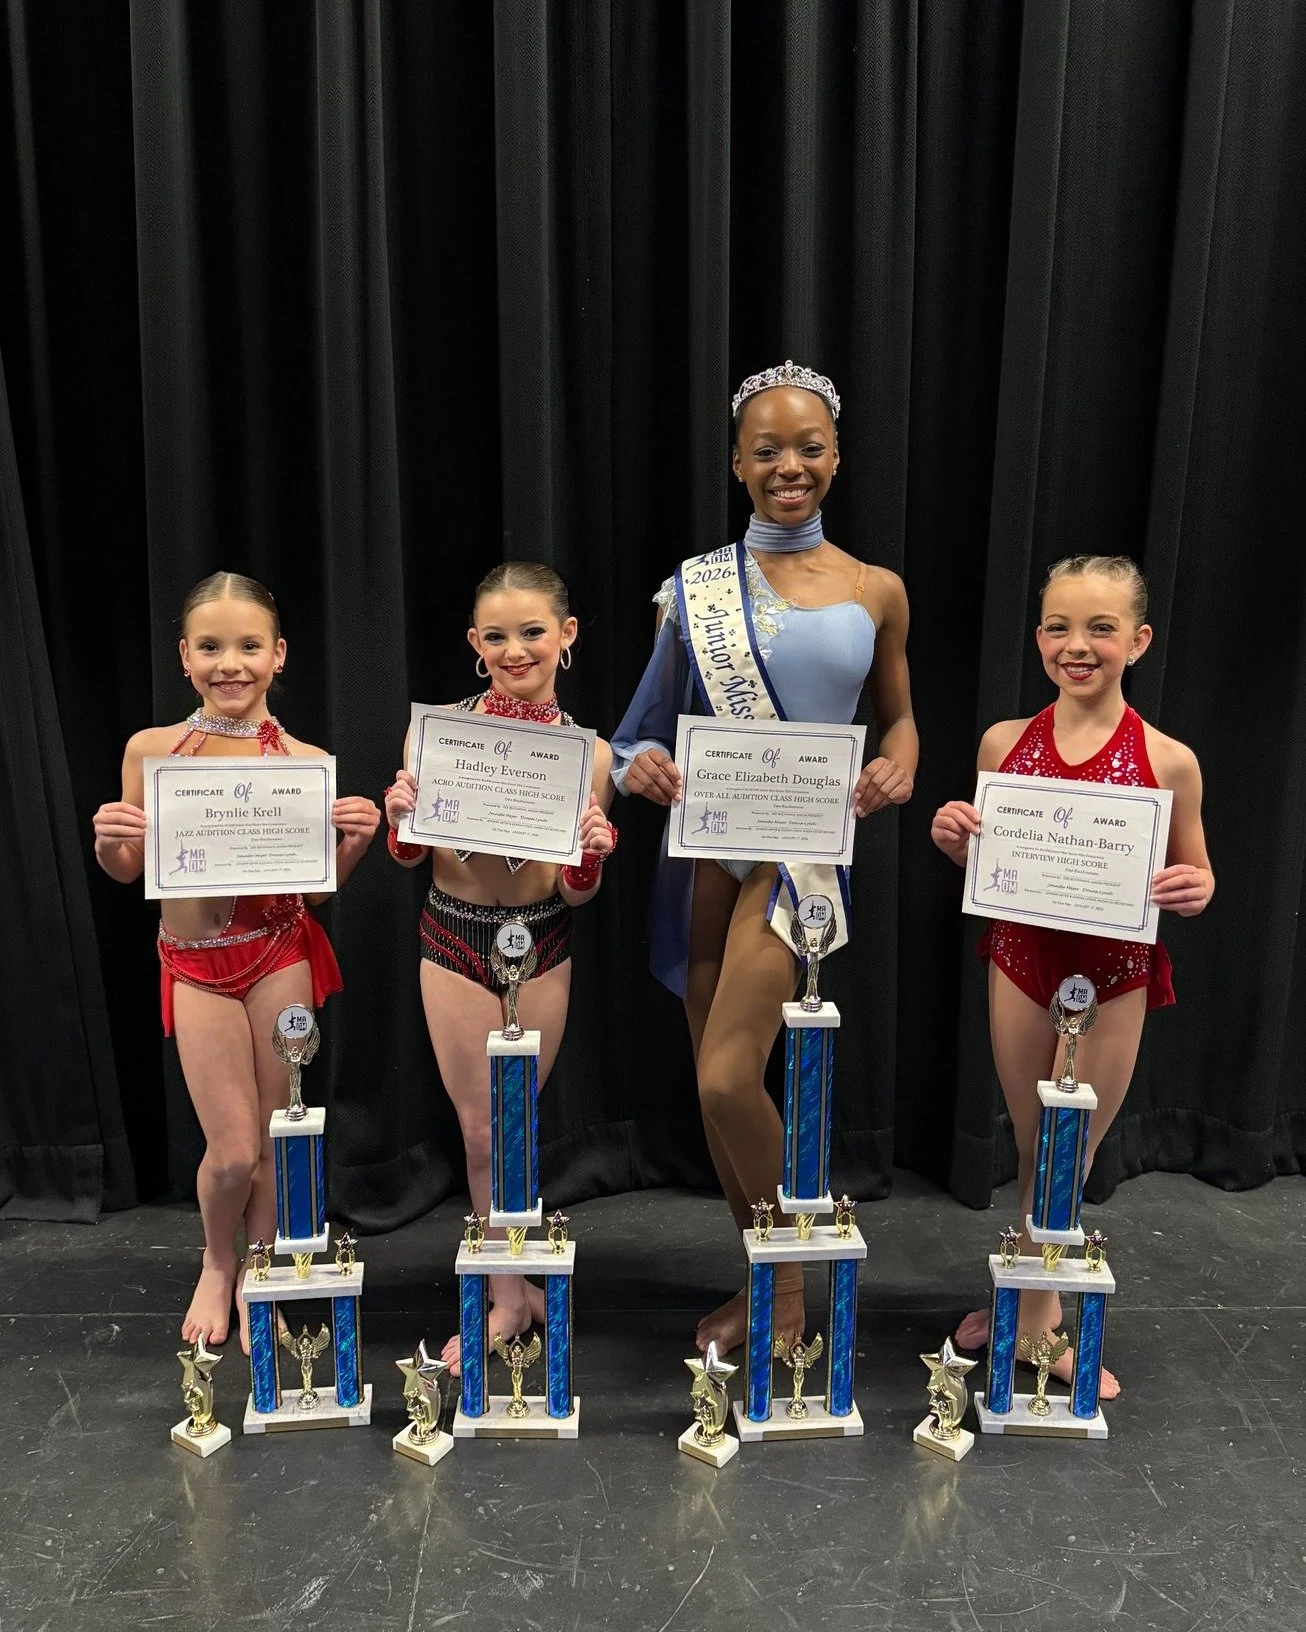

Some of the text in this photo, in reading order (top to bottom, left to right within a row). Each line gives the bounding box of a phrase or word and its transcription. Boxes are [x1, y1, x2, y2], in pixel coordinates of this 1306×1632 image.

[690, 566, 732, 585] 2026
[694, 610, 736, 670] Junior
[438, 738, 560, 760] CERTIFICATE Of AWARD
[705, 748, 828, 768] CERTIFICATE Of AWARD
[455, 759, 547, 781] Hadley Everson
[696, 769, 840, 789] Grace Elizabeth Douglas
[234, 782, 253, 802] Of
[432, 778, 454, 786] ACRO
[455, 782, 494, 792] AUDITION
[494, 786, 518, 795] CLASS
[518, 790, 540, 798] HIGH
[540, 792, 566, 802] SCORE
[694, 791, 730, 800] OVER-ALL
[732, 792, 768, 801] AUDITION
[205, 807, 282, 822] Brynlie Krell
[444, 799, 460, 810] MA
[713, 810, 728, 821] MA
[996, 806, 1126, 828] CERTIFICATE Of AWARD
[994, 825, 1044, 842] Cordelia
[1048, 832, 1134, 856] Nathan-Barry
[190, 848, 204, 859] MA
[1012, 850, 1056, 863] INTERVIEW
[1056, 856, 1080, 866] HIGH
[1080, 859, 1108, 870] SCORE
[1004, 868, 1018, 880] MA
